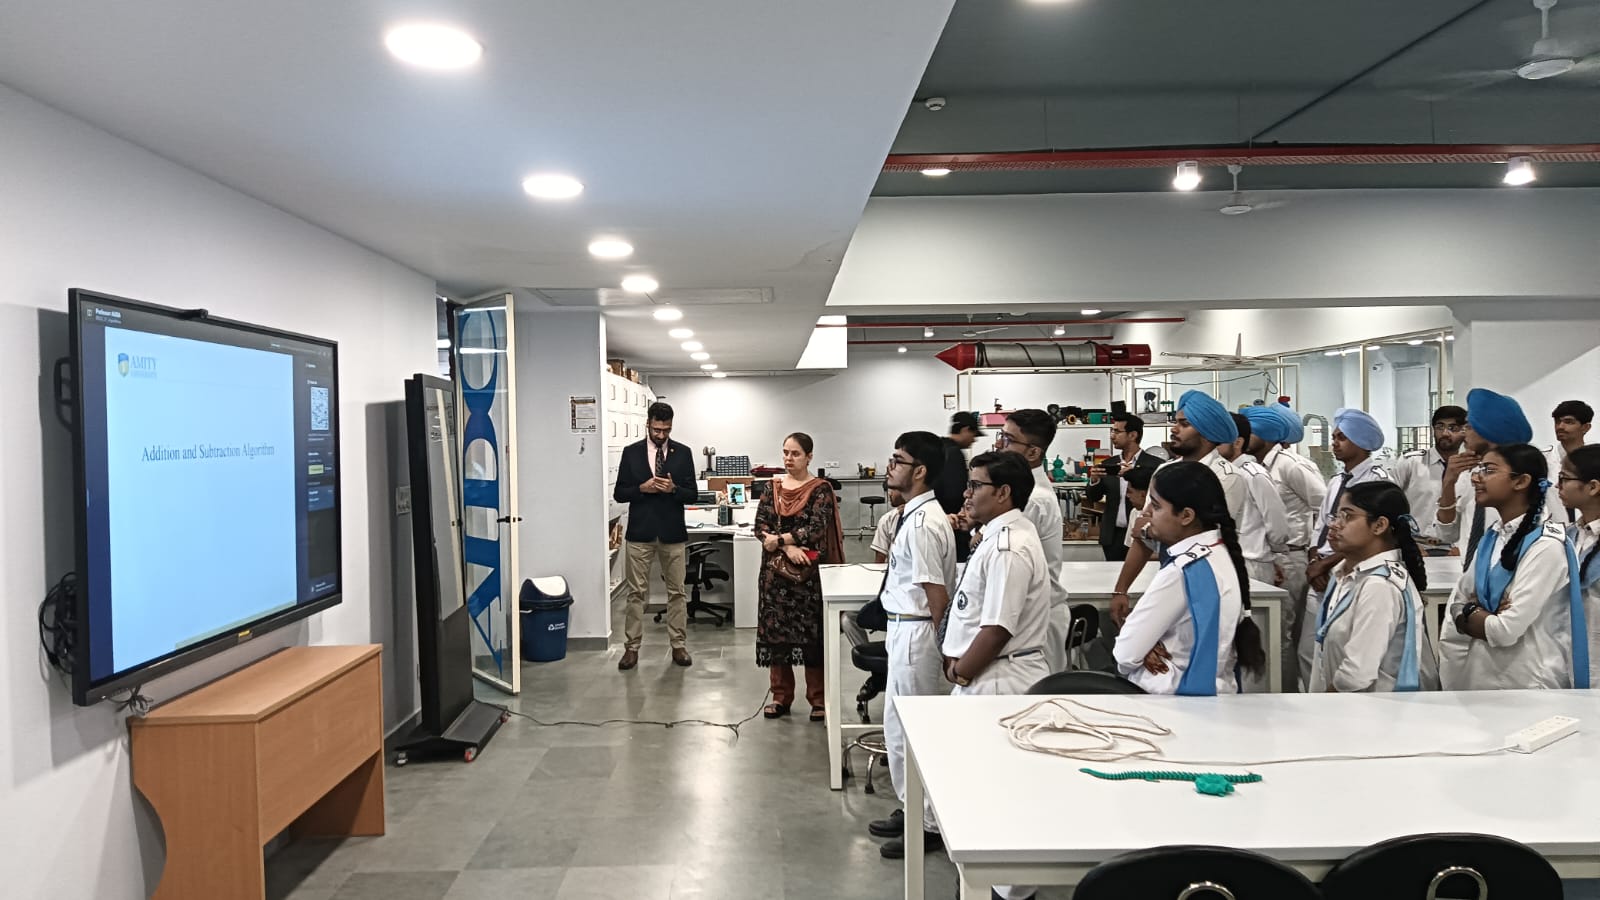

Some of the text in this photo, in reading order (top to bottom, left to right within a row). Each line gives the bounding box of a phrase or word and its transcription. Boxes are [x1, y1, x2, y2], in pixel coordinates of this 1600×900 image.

[130, 355, 158, 370] AMITY
[142, 441, 275, 462] Addition and Subtraction Algorithm
[458, 308, 502, 677] AIDC
